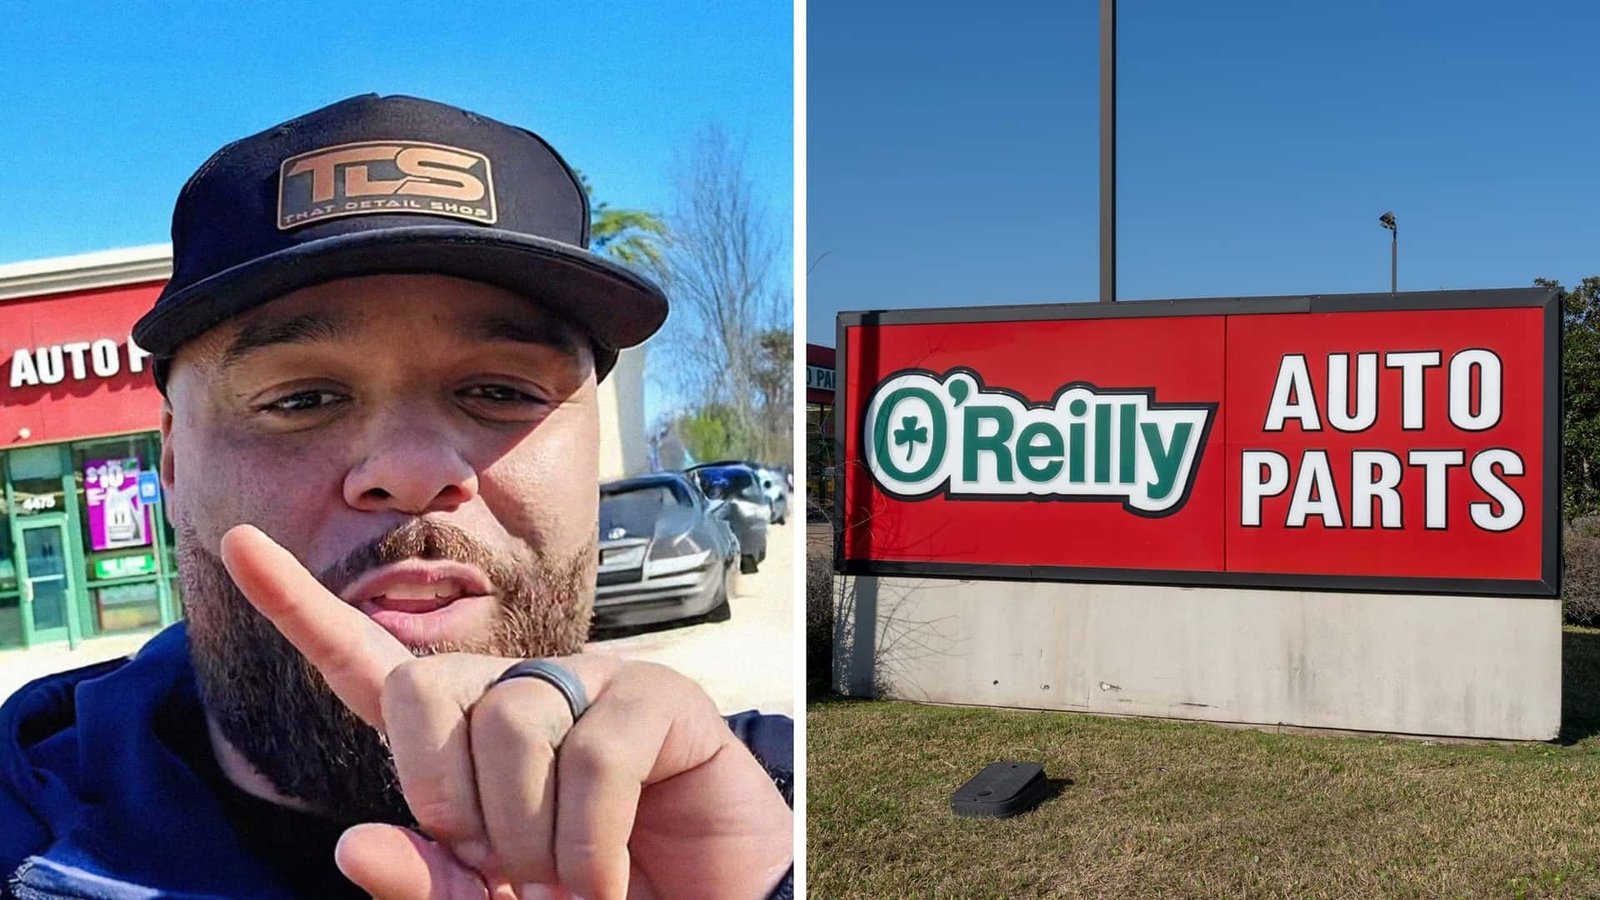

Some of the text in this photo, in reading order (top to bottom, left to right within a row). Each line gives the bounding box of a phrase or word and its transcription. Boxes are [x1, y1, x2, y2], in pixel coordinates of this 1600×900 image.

[286, 146, 485, 203] TLS
[284, 199, 488, 225] THAT DETAIL SHOP
[9, 338, 120, 388] AUTO
[1262, 347, 1503, 433] AUTO
[873, 377, 1194, 500] O'Reilly
[1240, 448, 1526, 533] PARTS
